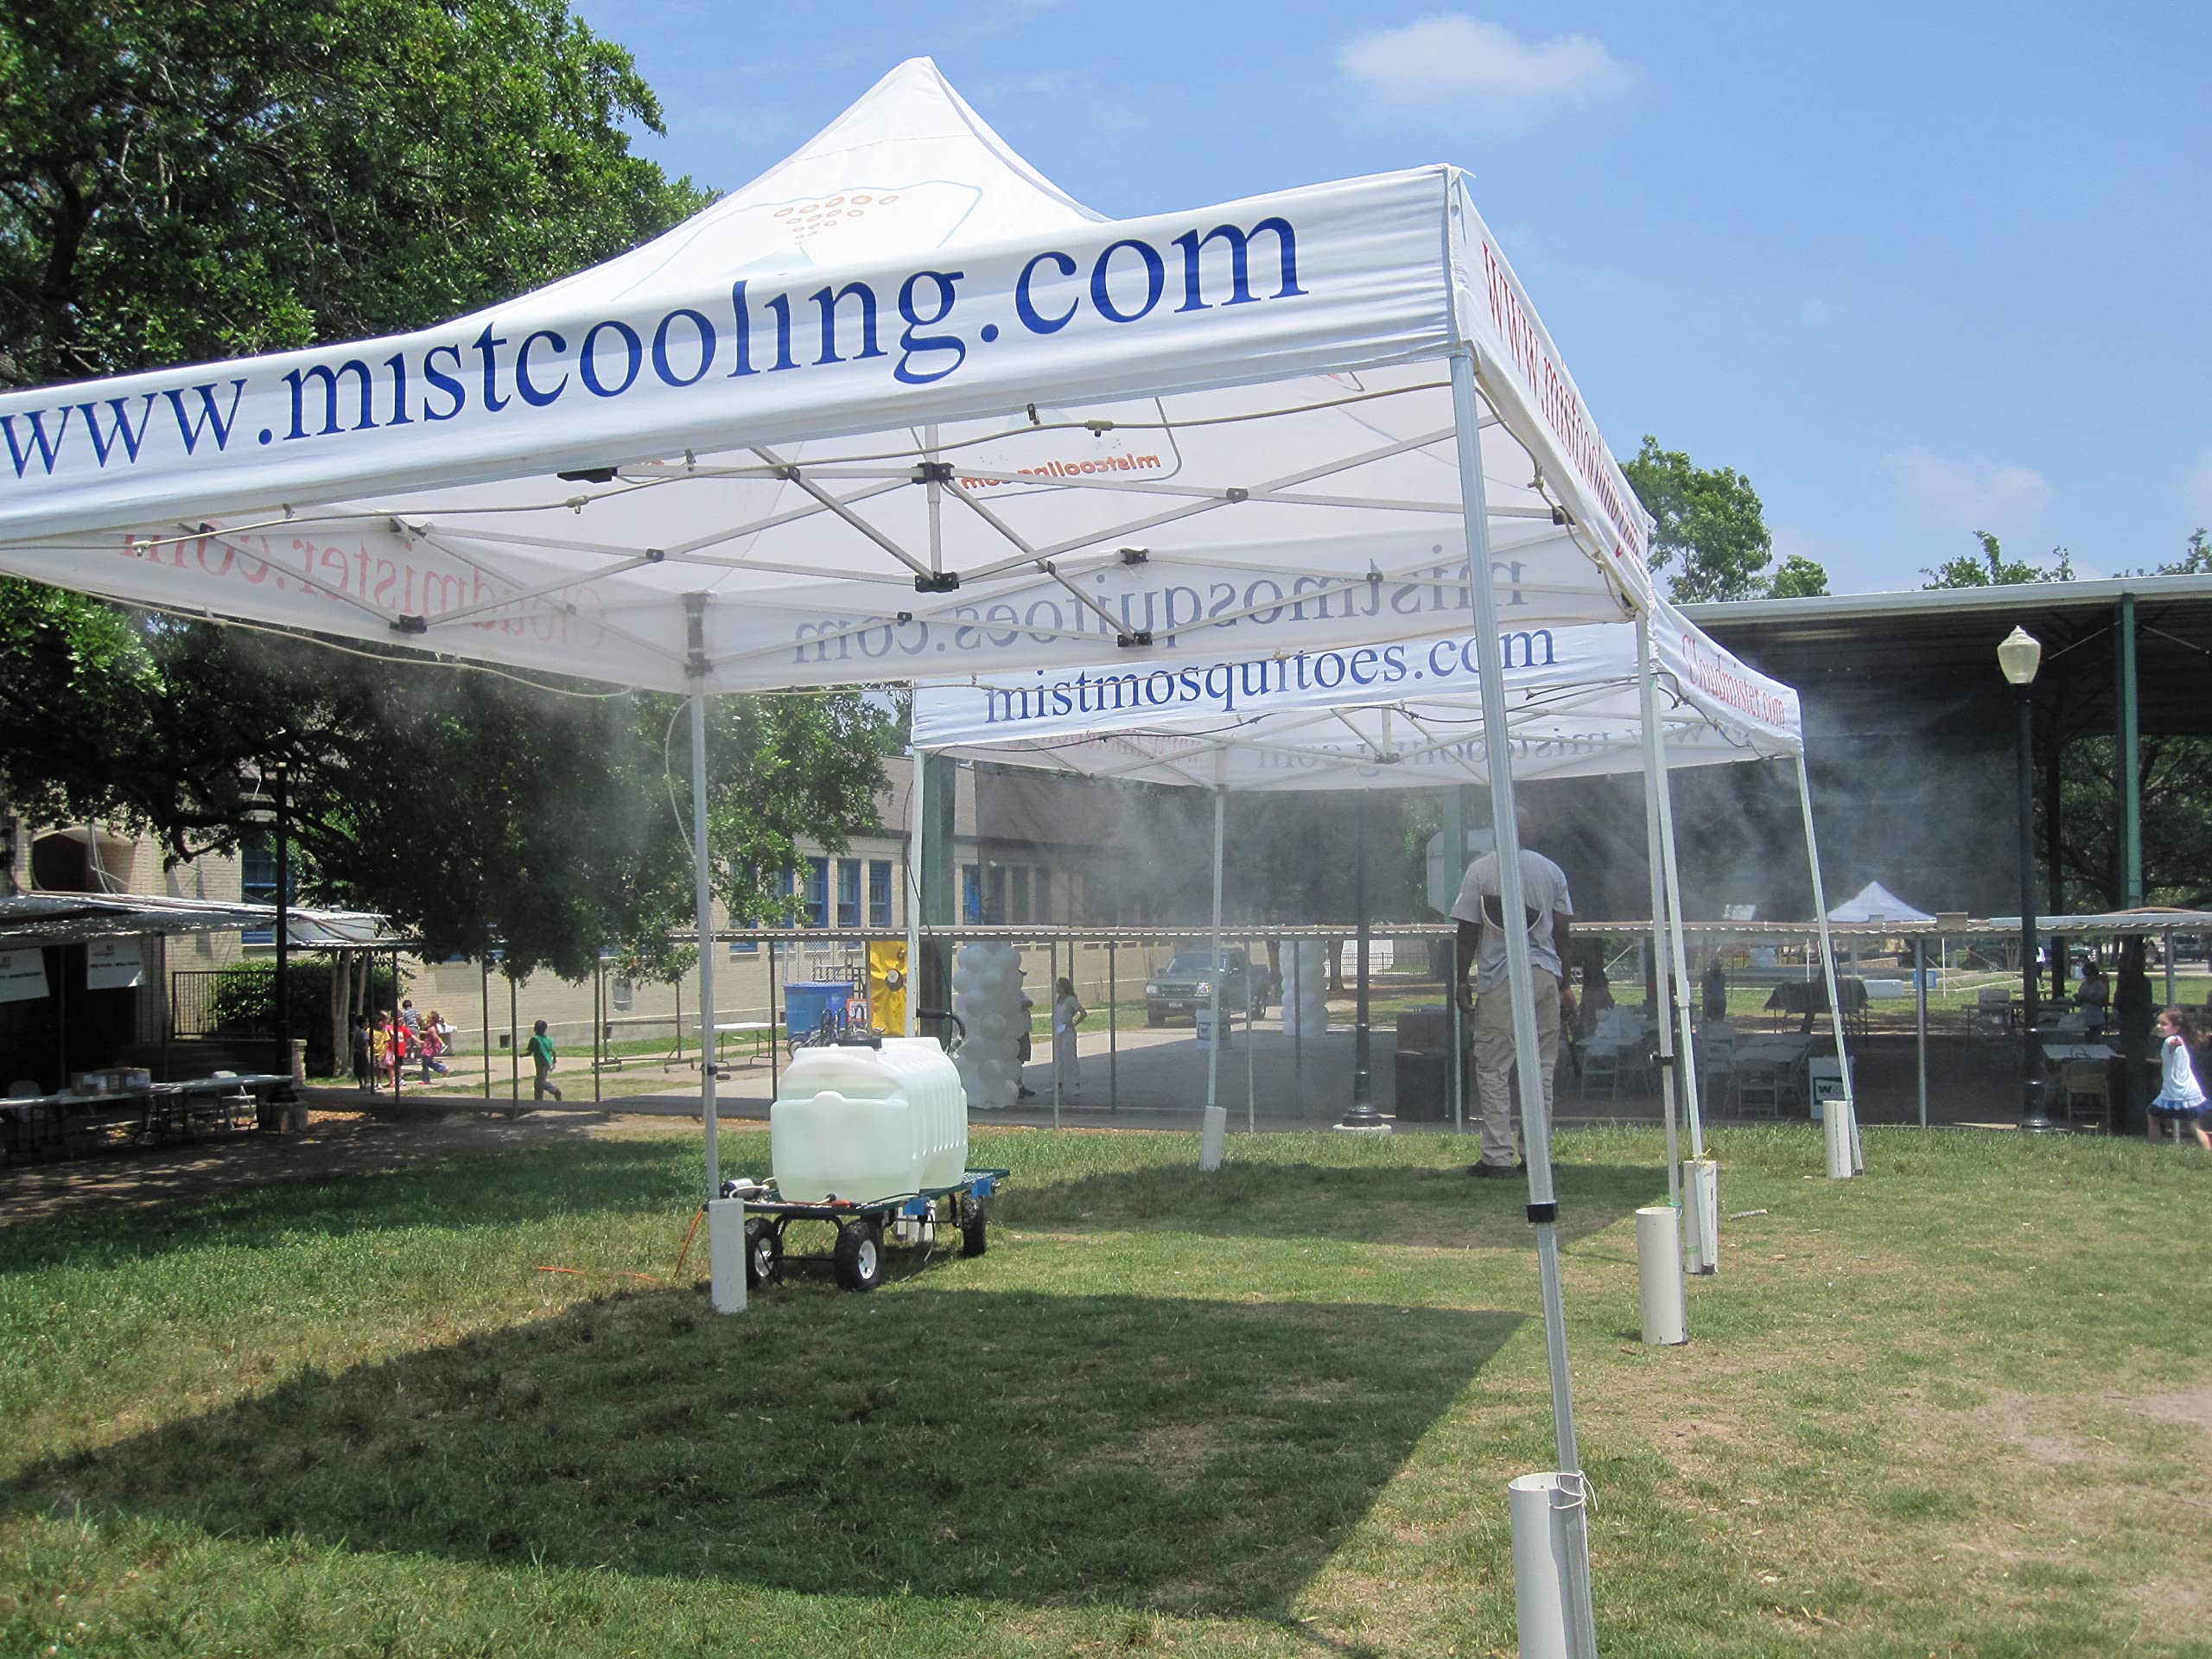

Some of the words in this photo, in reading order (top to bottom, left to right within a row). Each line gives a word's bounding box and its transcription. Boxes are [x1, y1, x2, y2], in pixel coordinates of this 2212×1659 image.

[0, 216, 1310, 480] www.mistcooling.com
[1482, 240, 1643, 574] www.mistcoolingcom
[985, 629, 1559, 724] mistmosquitoes.com
[1681, 633, 1785, 729] Cloudmister.com
